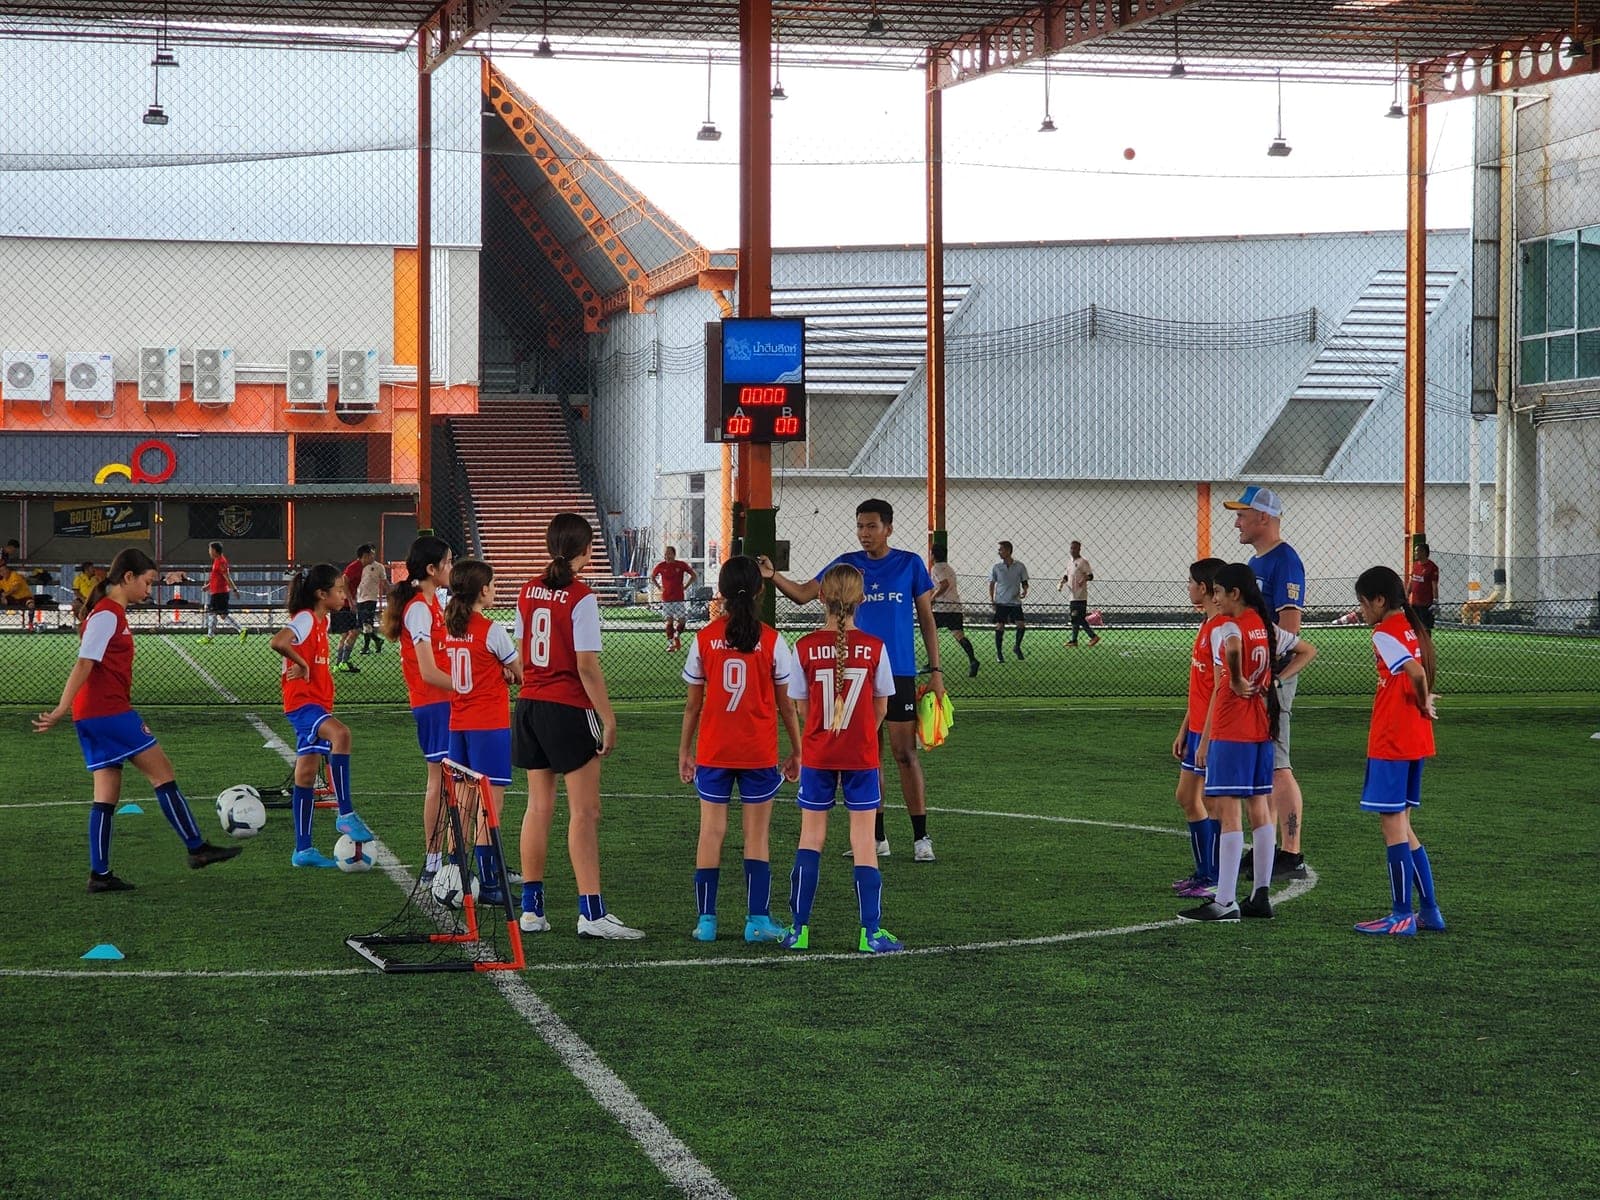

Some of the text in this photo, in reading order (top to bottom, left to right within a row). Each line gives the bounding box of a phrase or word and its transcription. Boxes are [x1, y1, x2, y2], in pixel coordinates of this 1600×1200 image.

[741, 388, 785, 404] 0000
[734, 406, 746, 418] A
[782, 406, 793, 418] B
[728, 418, 751, 434] 00
[775, 418, 798, 434] 00
[70, 508, 103, 525] GOLDEN
[91, 519, 113, 535] BOOT
[553, 589, 569, 604] FC
[888, 592, 904, 603] FC
[531, 607, 552, 668] 8
[854, 645, 872, 660] FC
[446, 647, 474, 695] 10
[1248, 646, 1268, 686] 2
[723, 658, 747, 712] 9
[815, 667, 869, 730] 17
